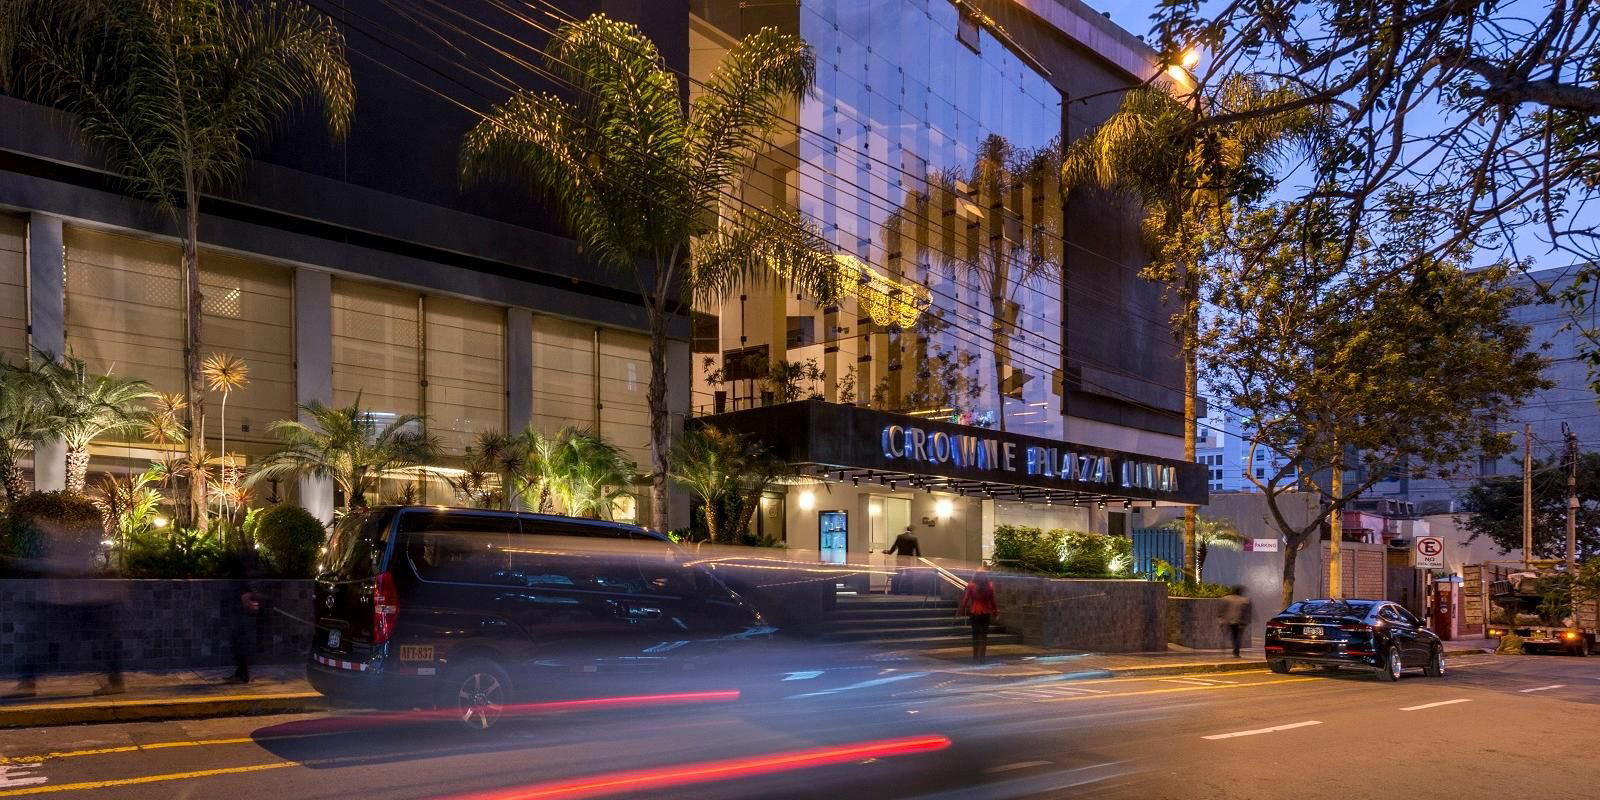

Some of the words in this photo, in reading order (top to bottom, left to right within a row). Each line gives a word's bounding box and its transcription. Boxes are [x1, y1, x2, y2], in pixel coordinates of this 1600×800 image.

[881, 425, 1016, 472] CROWNE
[1027, 446, 1114, 483] PLAZA
[1425, 541, 1436, 553] E
